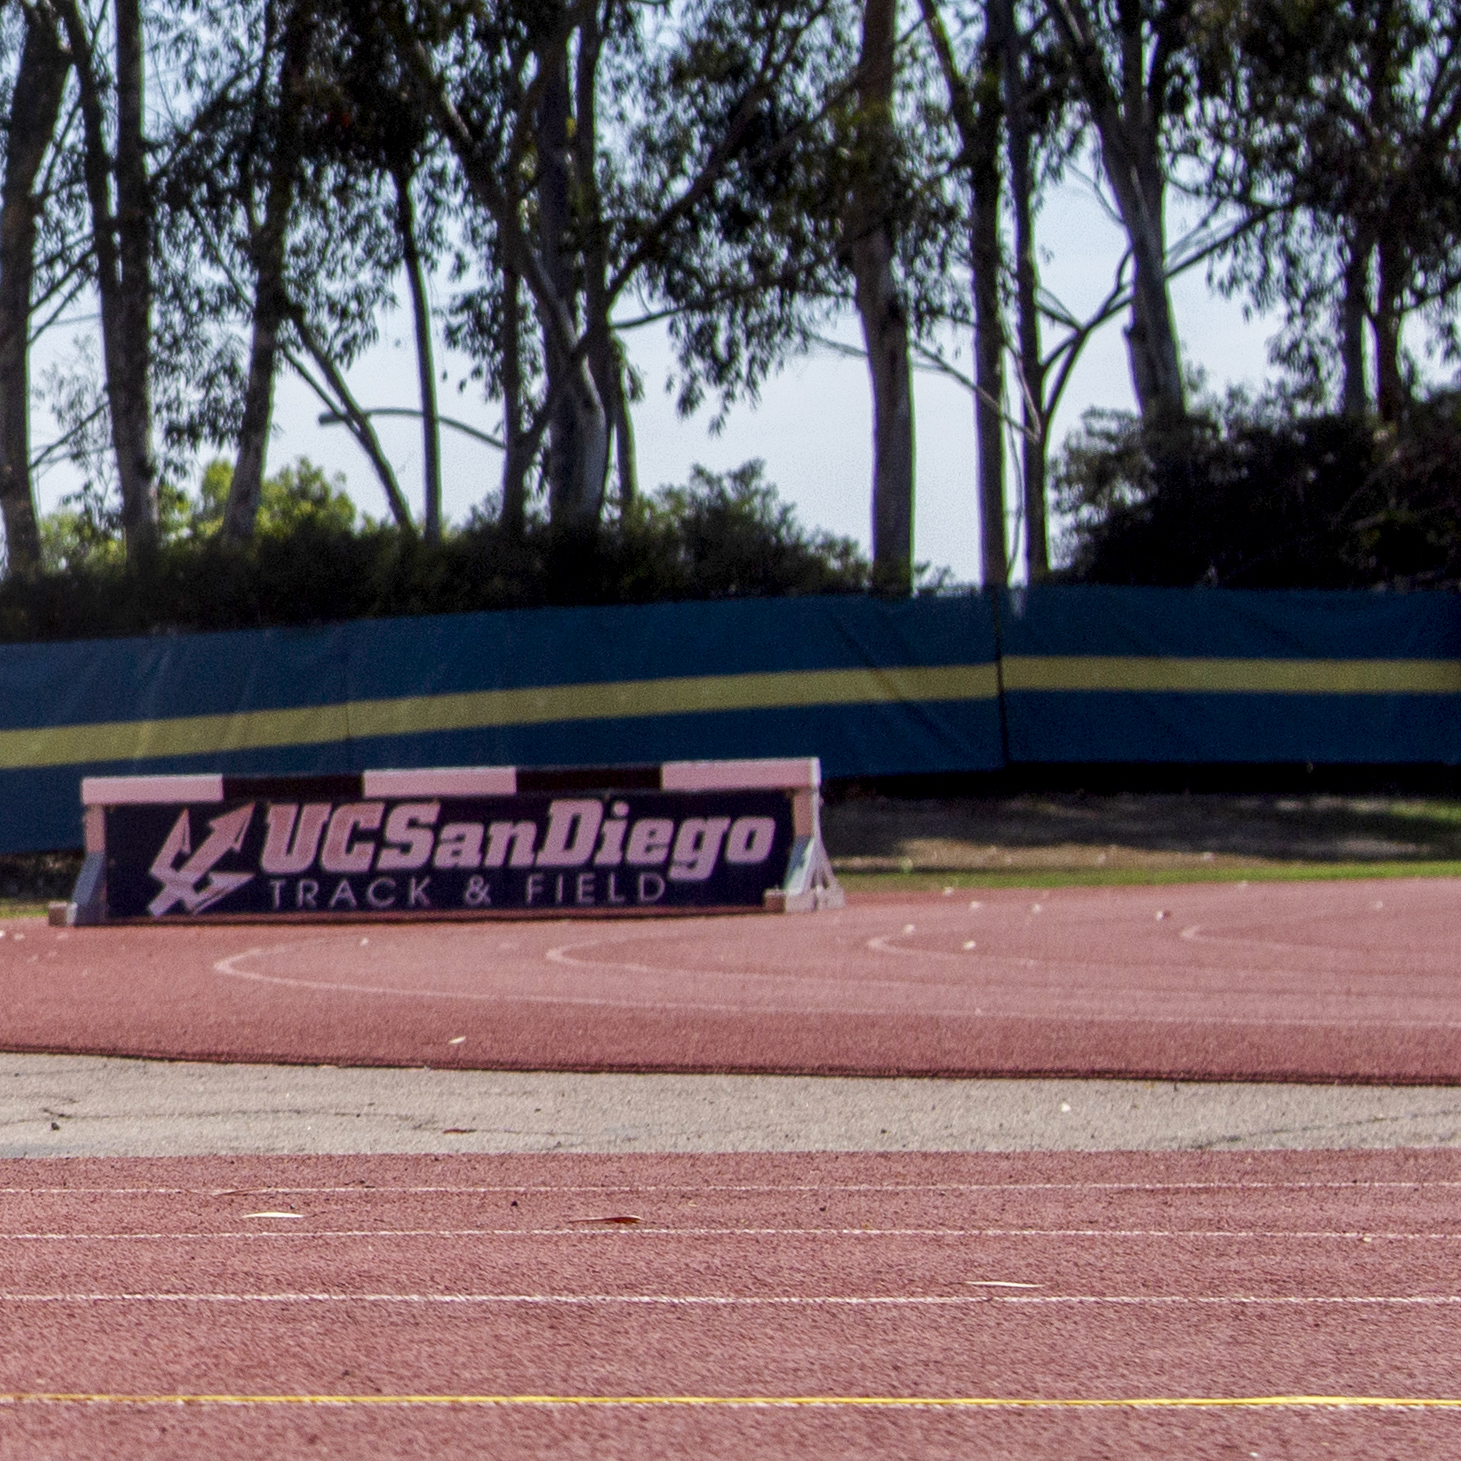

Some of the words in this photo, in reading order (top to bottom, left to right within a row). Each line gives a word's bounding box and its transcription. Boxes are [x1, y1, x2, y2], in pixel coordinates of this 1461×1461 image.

[269, 876, 431, 909] TRACK
[463, 875, 492, 905] &
[525, 872, 667, 905] FIELD
